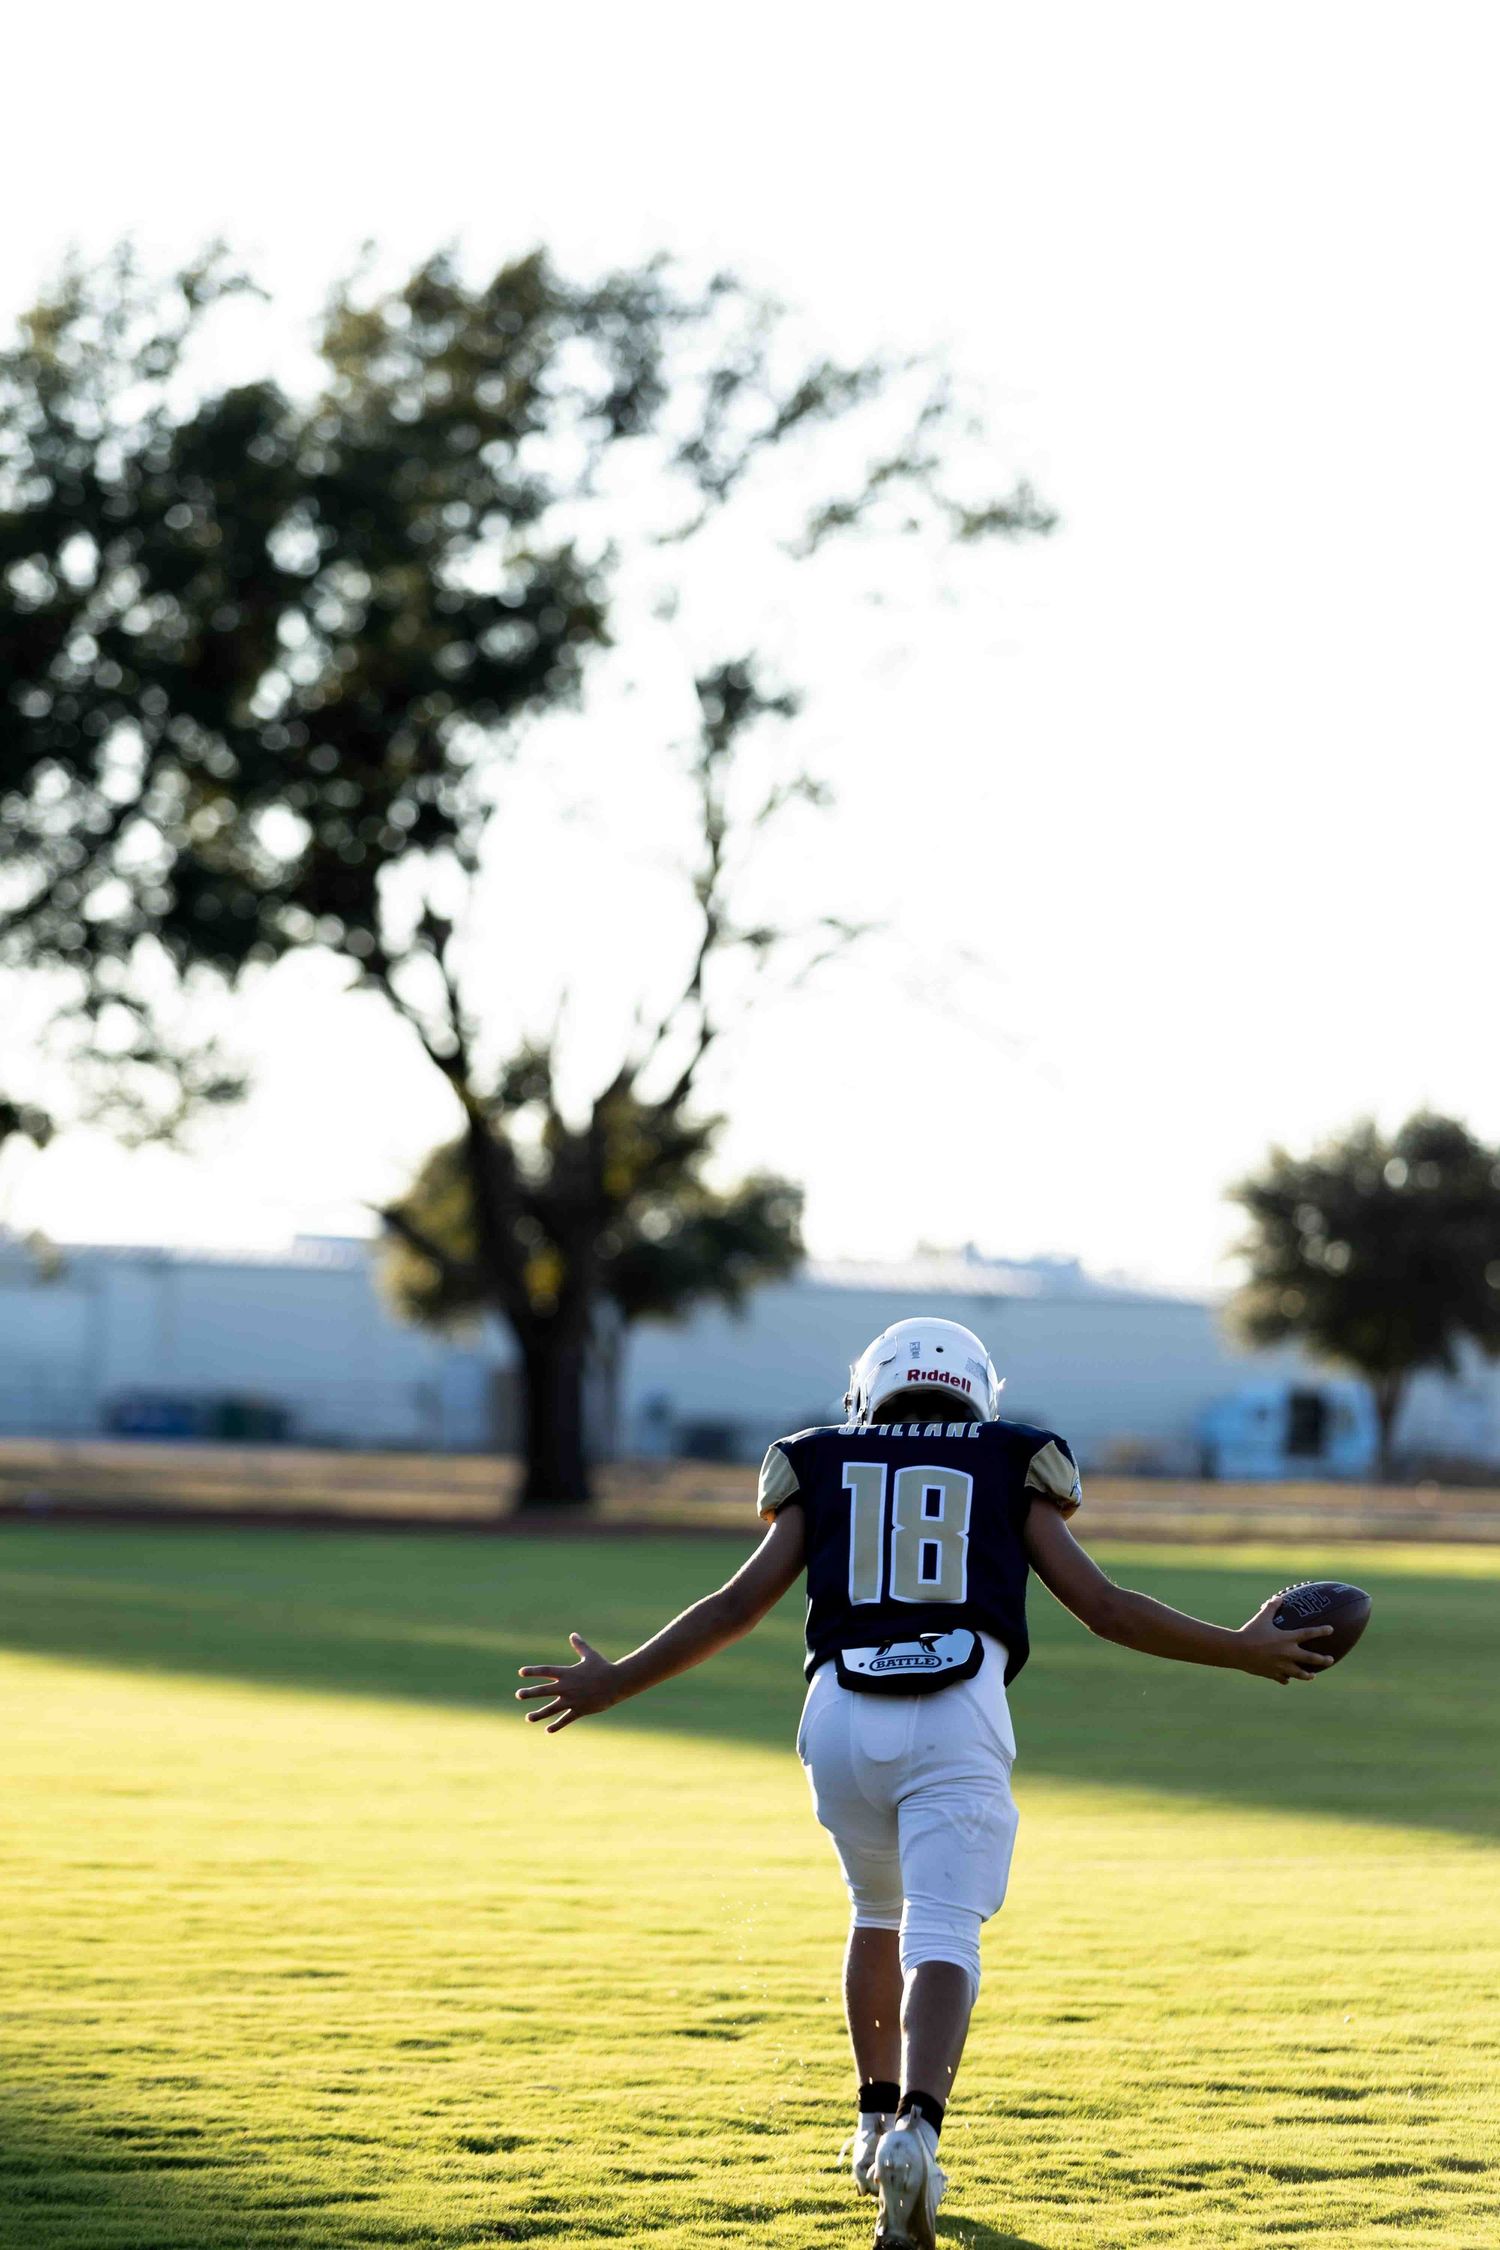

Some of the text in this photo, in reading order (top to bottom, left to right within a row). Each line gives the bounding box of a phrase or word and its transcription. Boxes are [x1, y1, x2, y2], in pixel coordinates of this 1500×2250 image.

[907, 1369, 971, 1393] Riddell
[842, 1462, 973, 1606] 18
[1290, 1591, 1331, 1617] NFL
[876, 1657, 935, 1669] BATTLE
